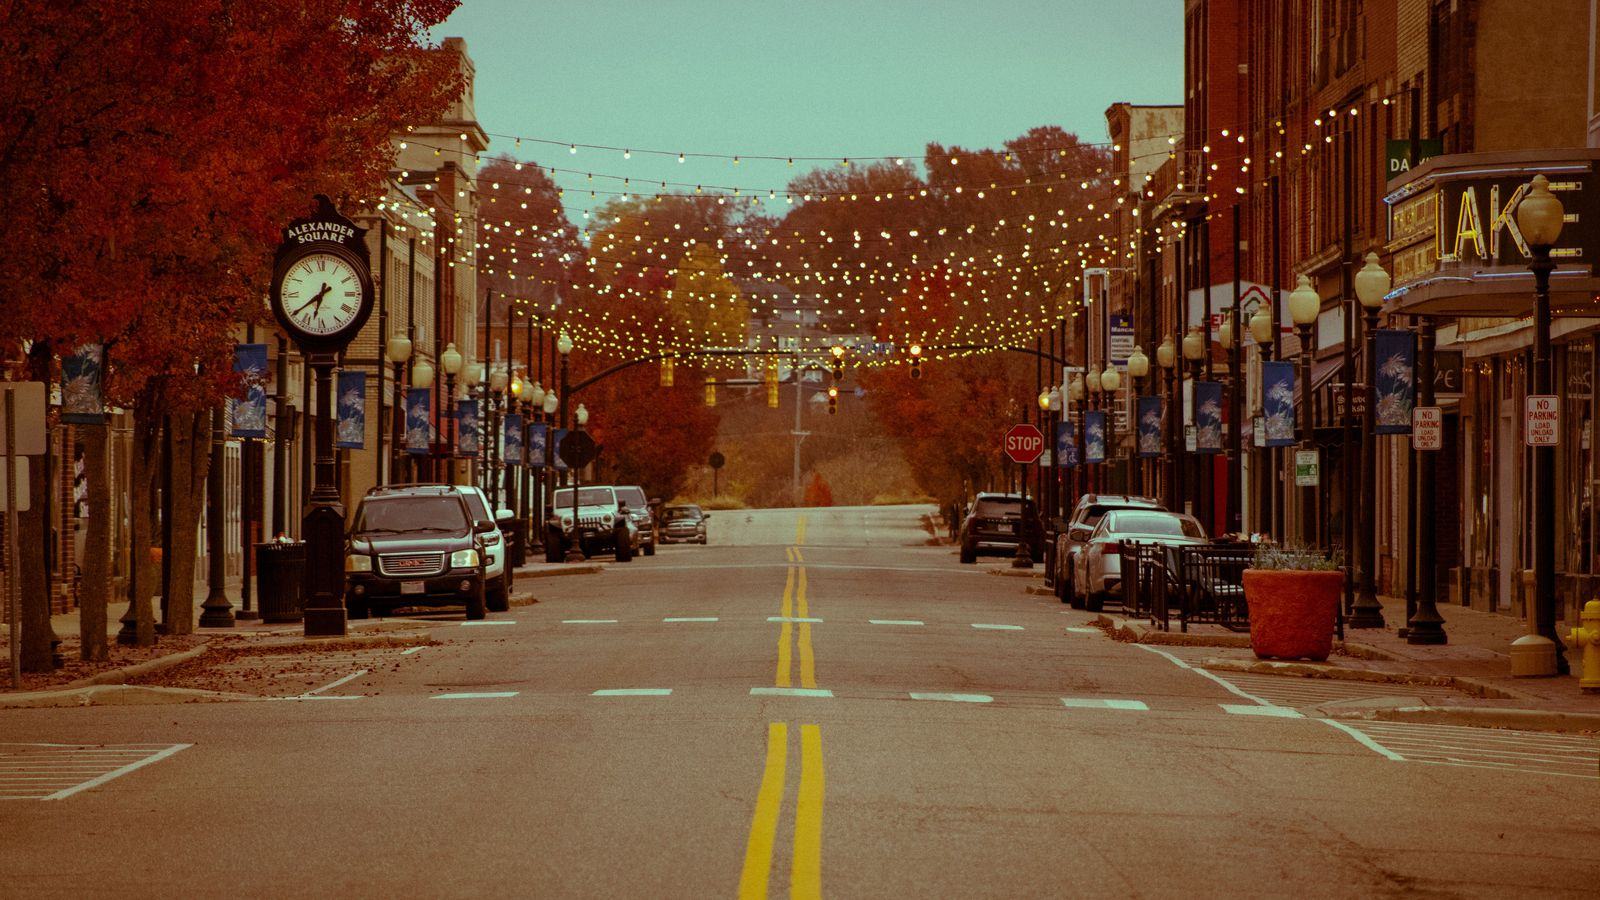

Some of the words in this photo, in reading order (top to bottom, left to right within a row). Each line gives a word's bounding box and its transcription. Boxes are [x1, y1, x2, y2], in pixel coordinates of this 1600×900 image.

[288, 222, 354, 238] ALEXANDER
[298, 231, 346, 244] SQUARE
[1536, 400, 1549, 410] NO
[1422, 411, 1433, 420] NO
[1529, 411, 1557, 421] PARKING
[1415, 420, 1440, 429] PARKING
[1008, 436, 1041, 451] STOP
